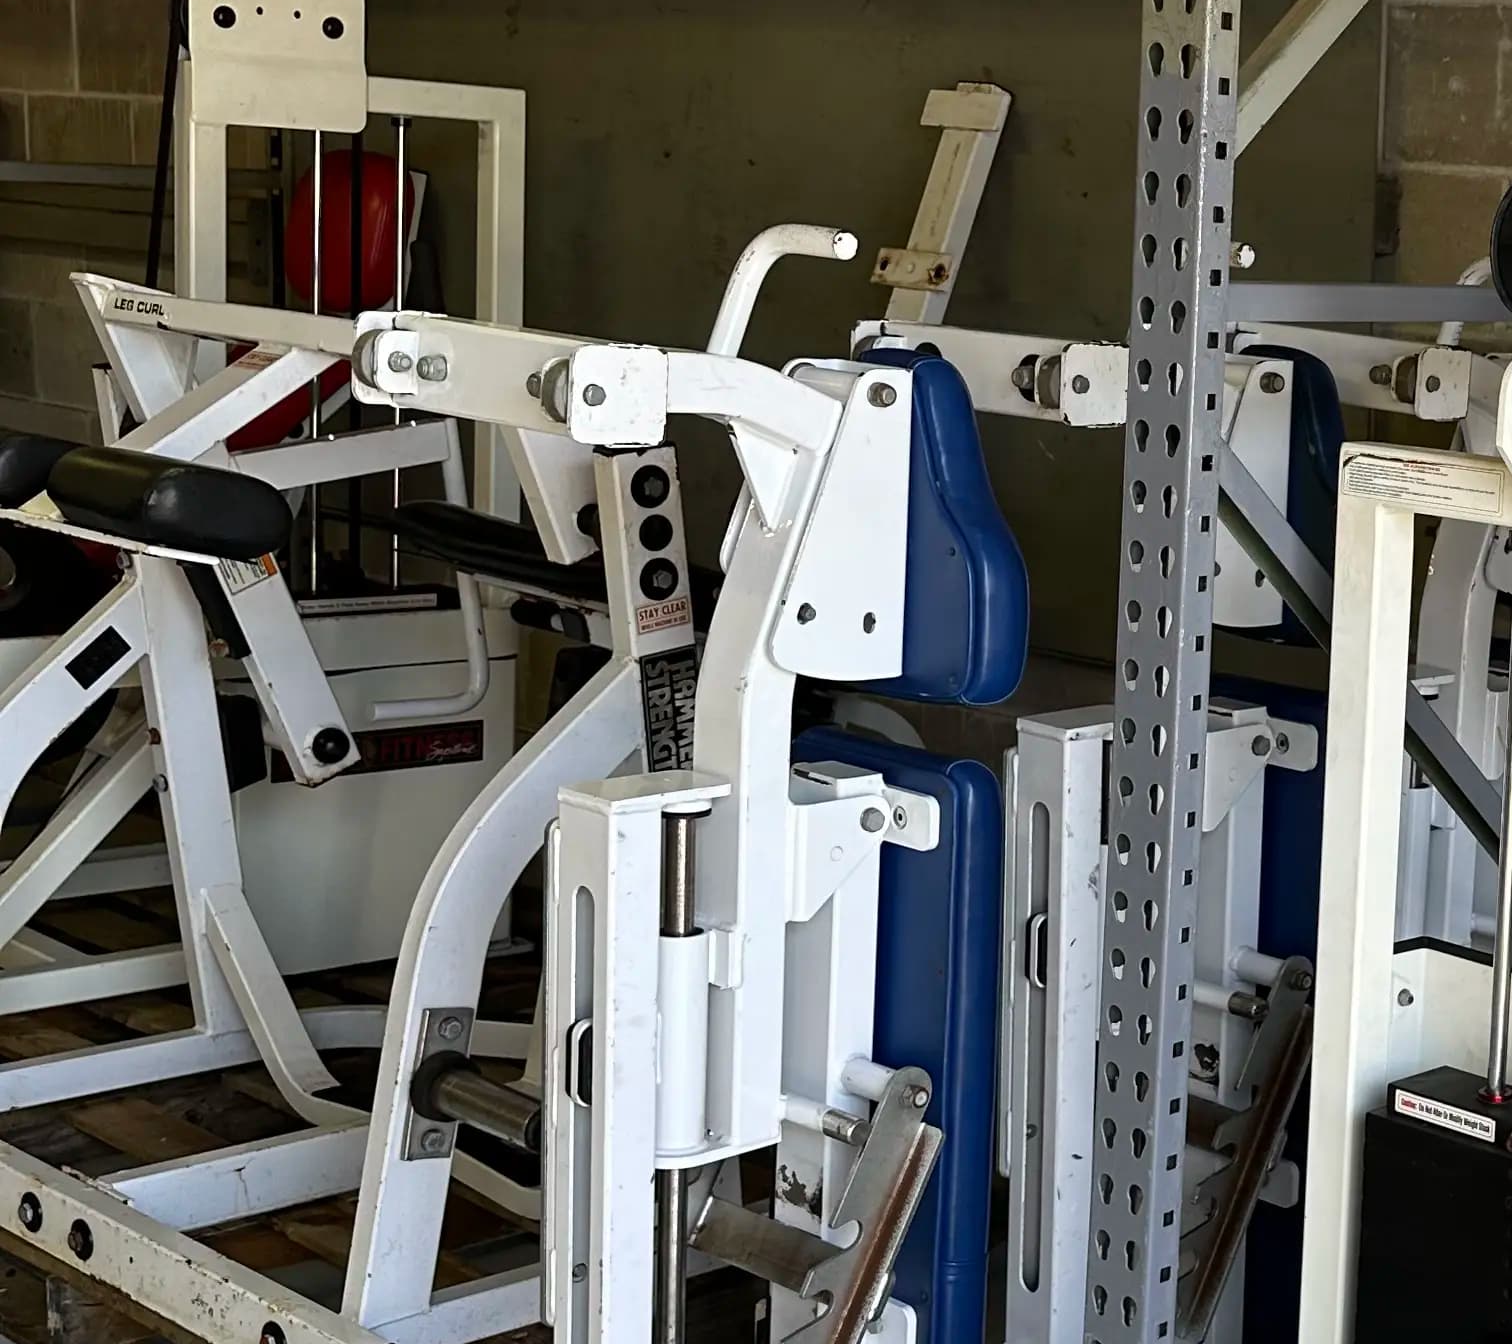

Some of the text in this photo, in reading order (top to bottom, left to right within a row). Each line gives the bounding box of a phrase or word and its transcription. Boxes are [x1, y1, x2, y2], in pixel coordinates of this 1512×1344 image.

[113, 297, 165, 316] LEG CURL
[639, 600, 687, 622] STAY CLEAR
